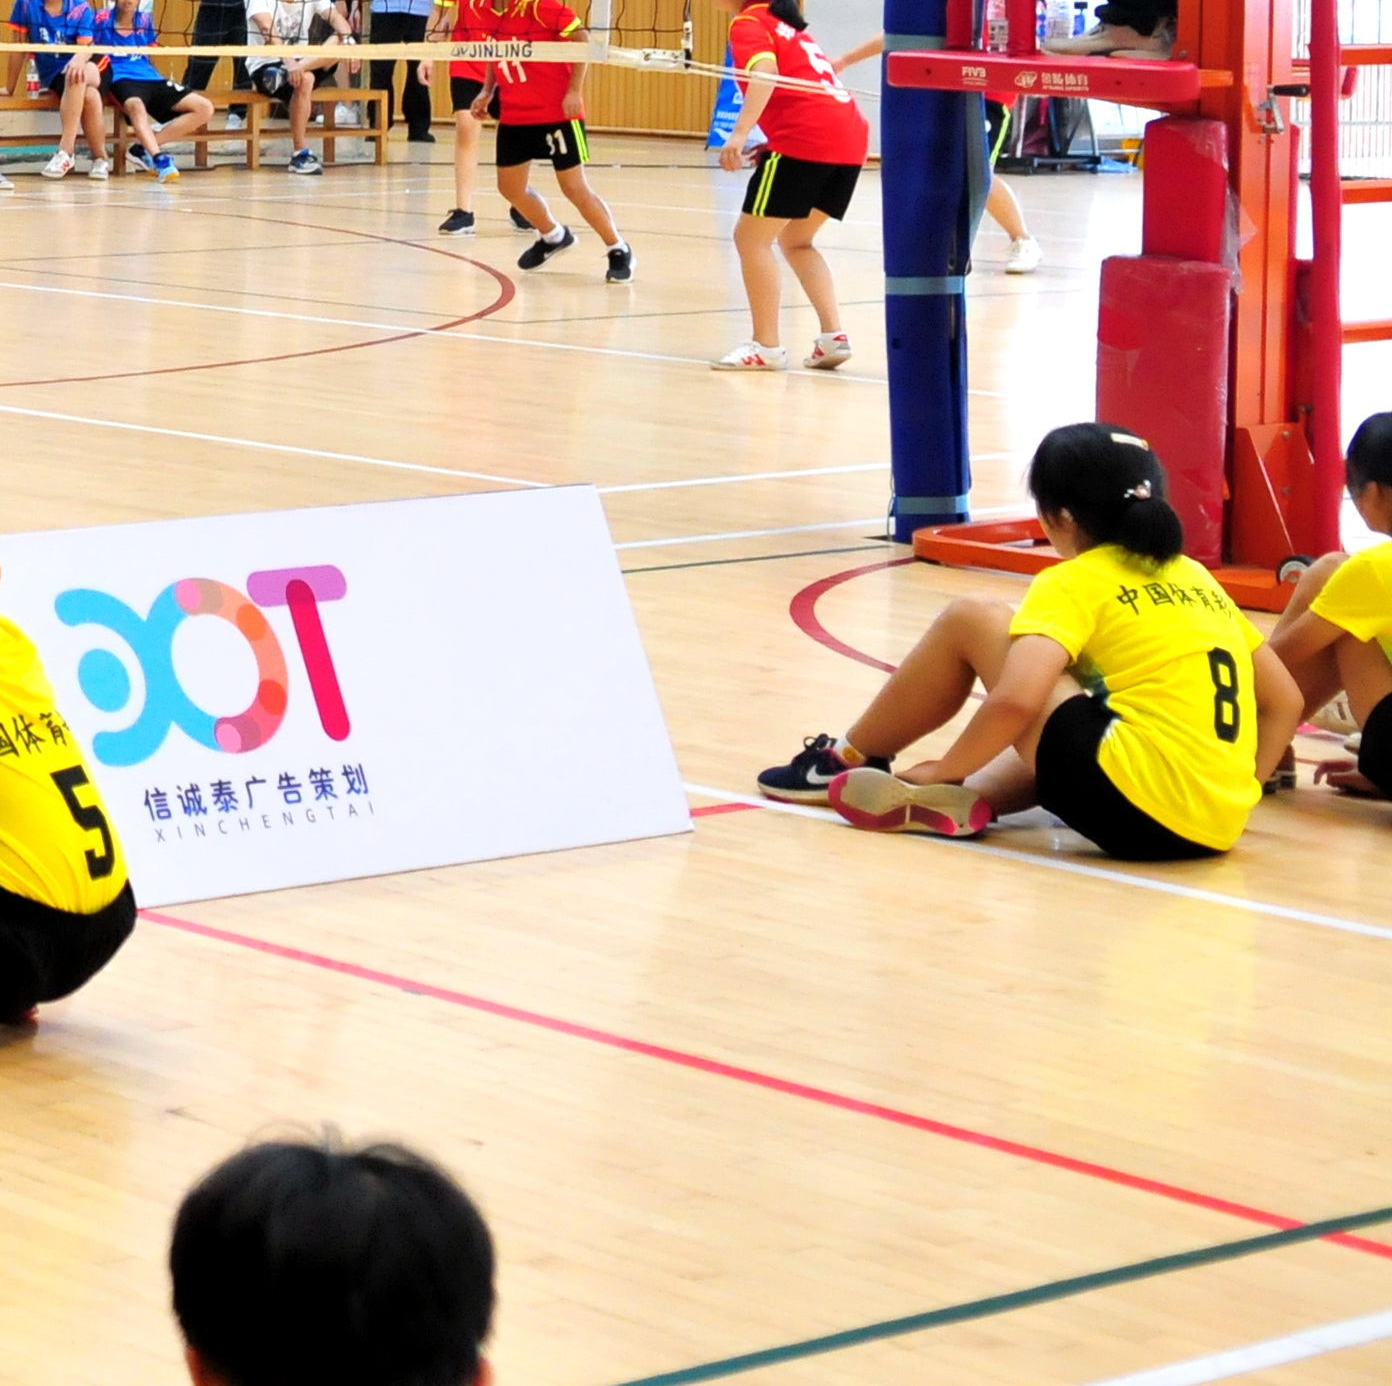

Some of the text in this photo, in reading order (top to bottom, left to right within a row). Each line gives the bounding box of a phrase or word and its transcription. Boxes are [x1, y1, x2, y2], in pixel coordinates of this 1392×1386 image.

[469, 43, 533, 58] JINLING
[800, 40, 852, 103] 5
[961, 66, 986, 78] FIVB
[1207, 647, 1241, 744] 8
[50, 764, 115, 881] 5
[143, 763, 370, 822] 信诚泰广告策划
